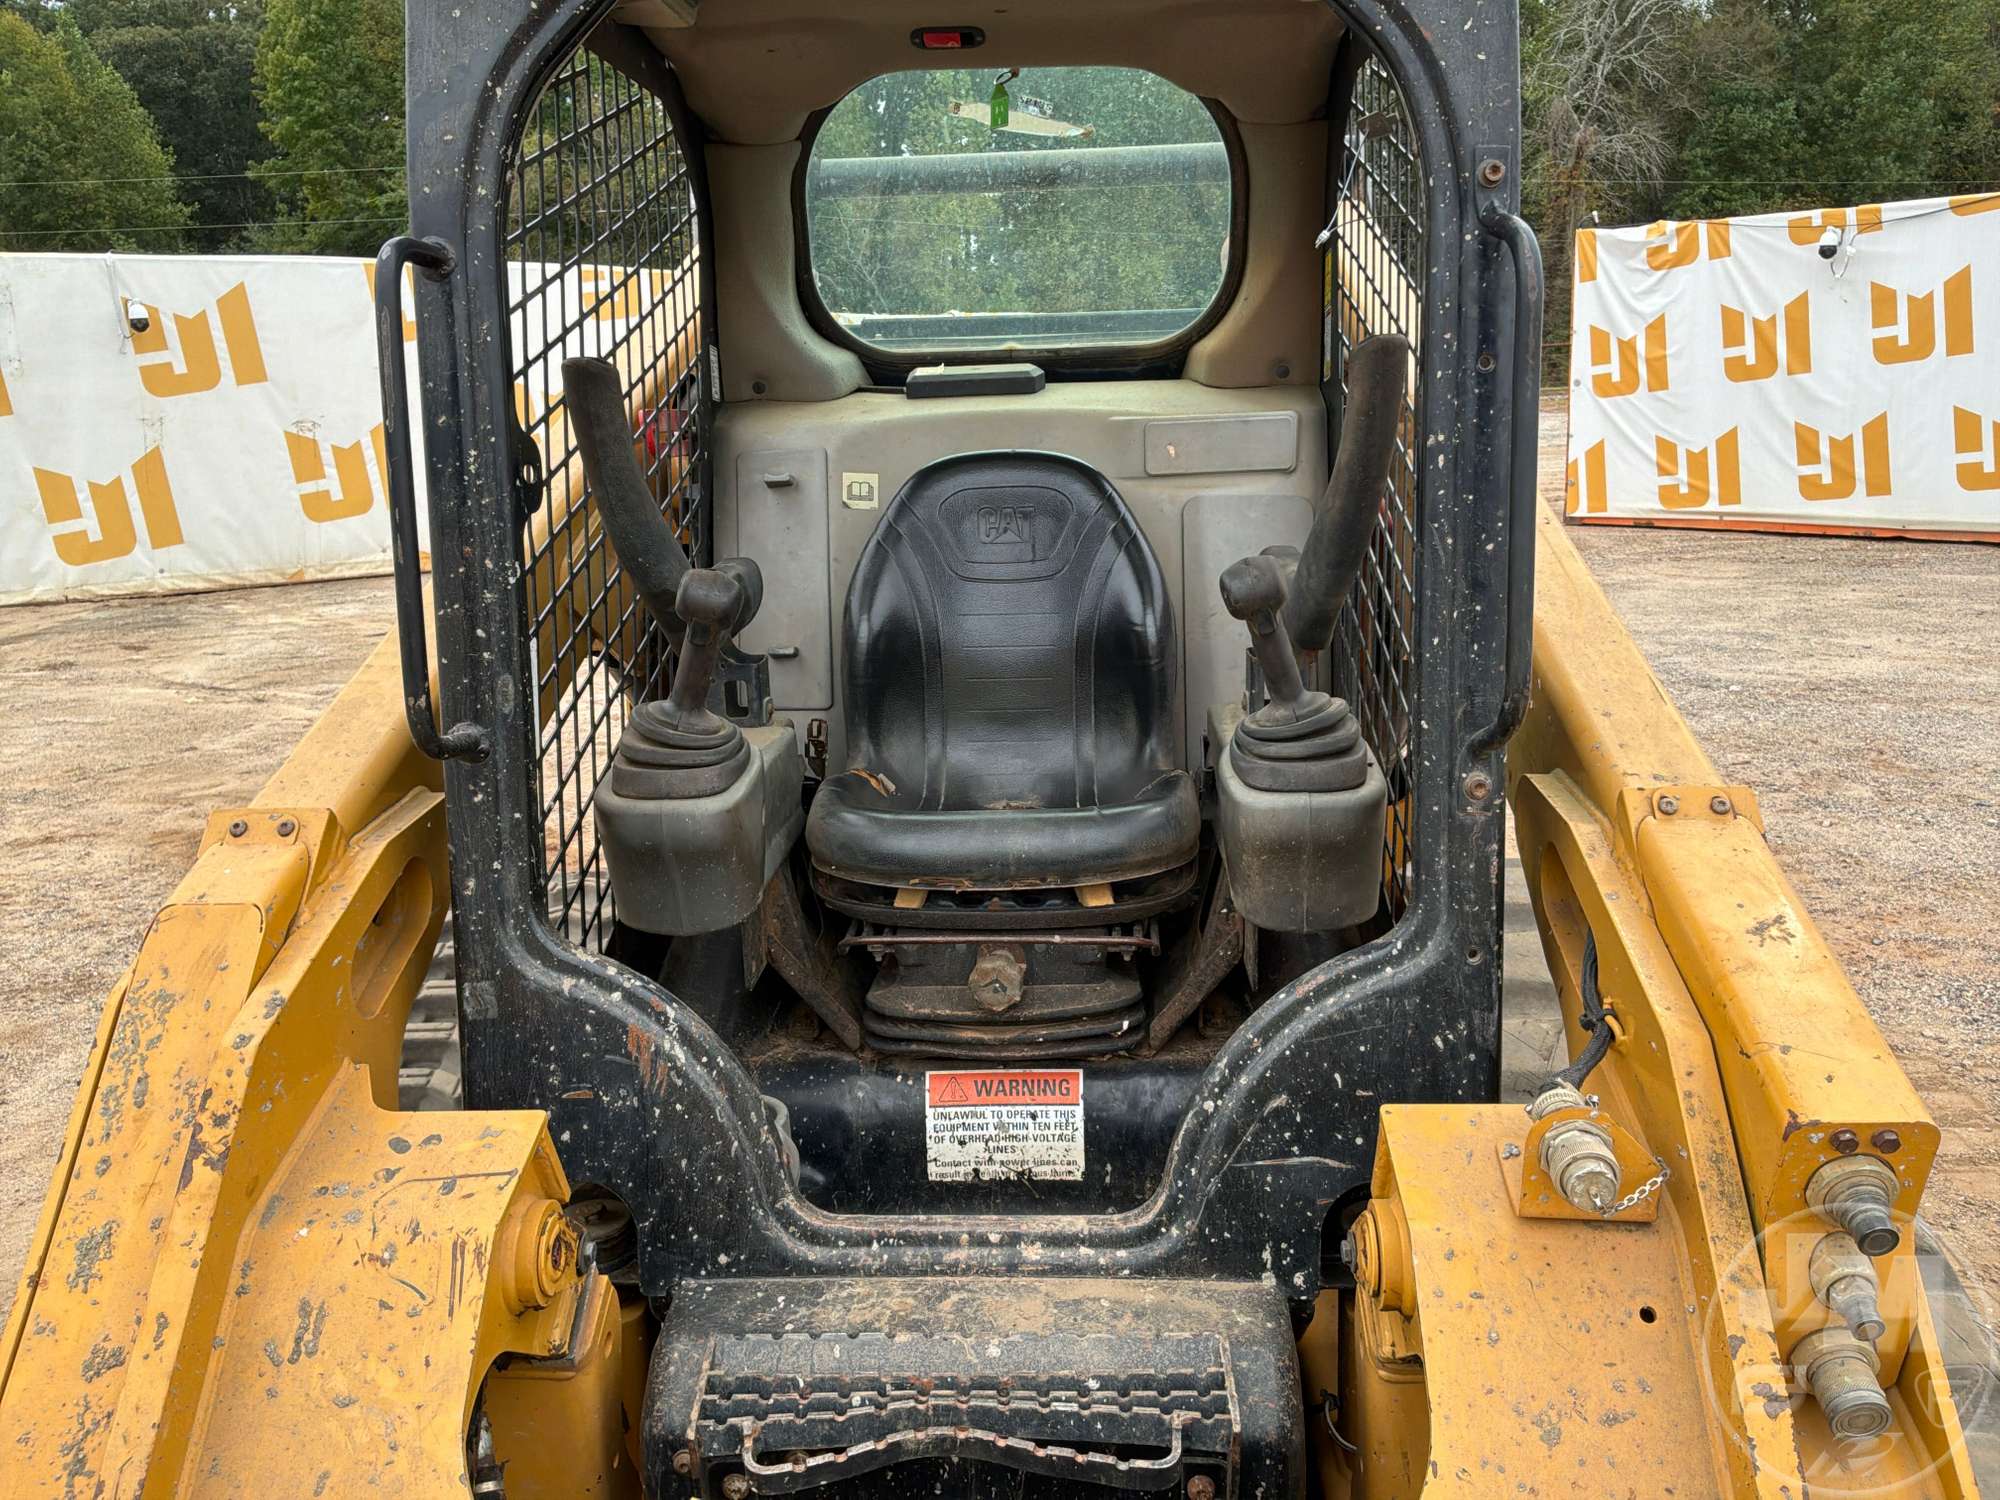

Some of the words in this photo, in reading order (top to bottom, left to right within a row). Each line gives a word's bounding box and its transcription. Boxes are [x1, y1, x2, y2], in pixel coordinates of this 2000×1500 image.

[977, 506, 1035, 544] CAT
[974, 1079, 1070, 1097] WARNING
[991, 1110, 1003, 1119] TO
[1054, 1109, 1076, 1119] THIS
[933, 1122, 989, 1132] EQUIPMENT
[1032, 1121, 1051, 1130] TEN
[934, 1135, 946, 1144] OF
[949, 1134, 1001, 1144] OVERHEAD
[1032, 1133, 1077, 1143] VOLTAGE
[935, 1159, 971, 1168] Contact
